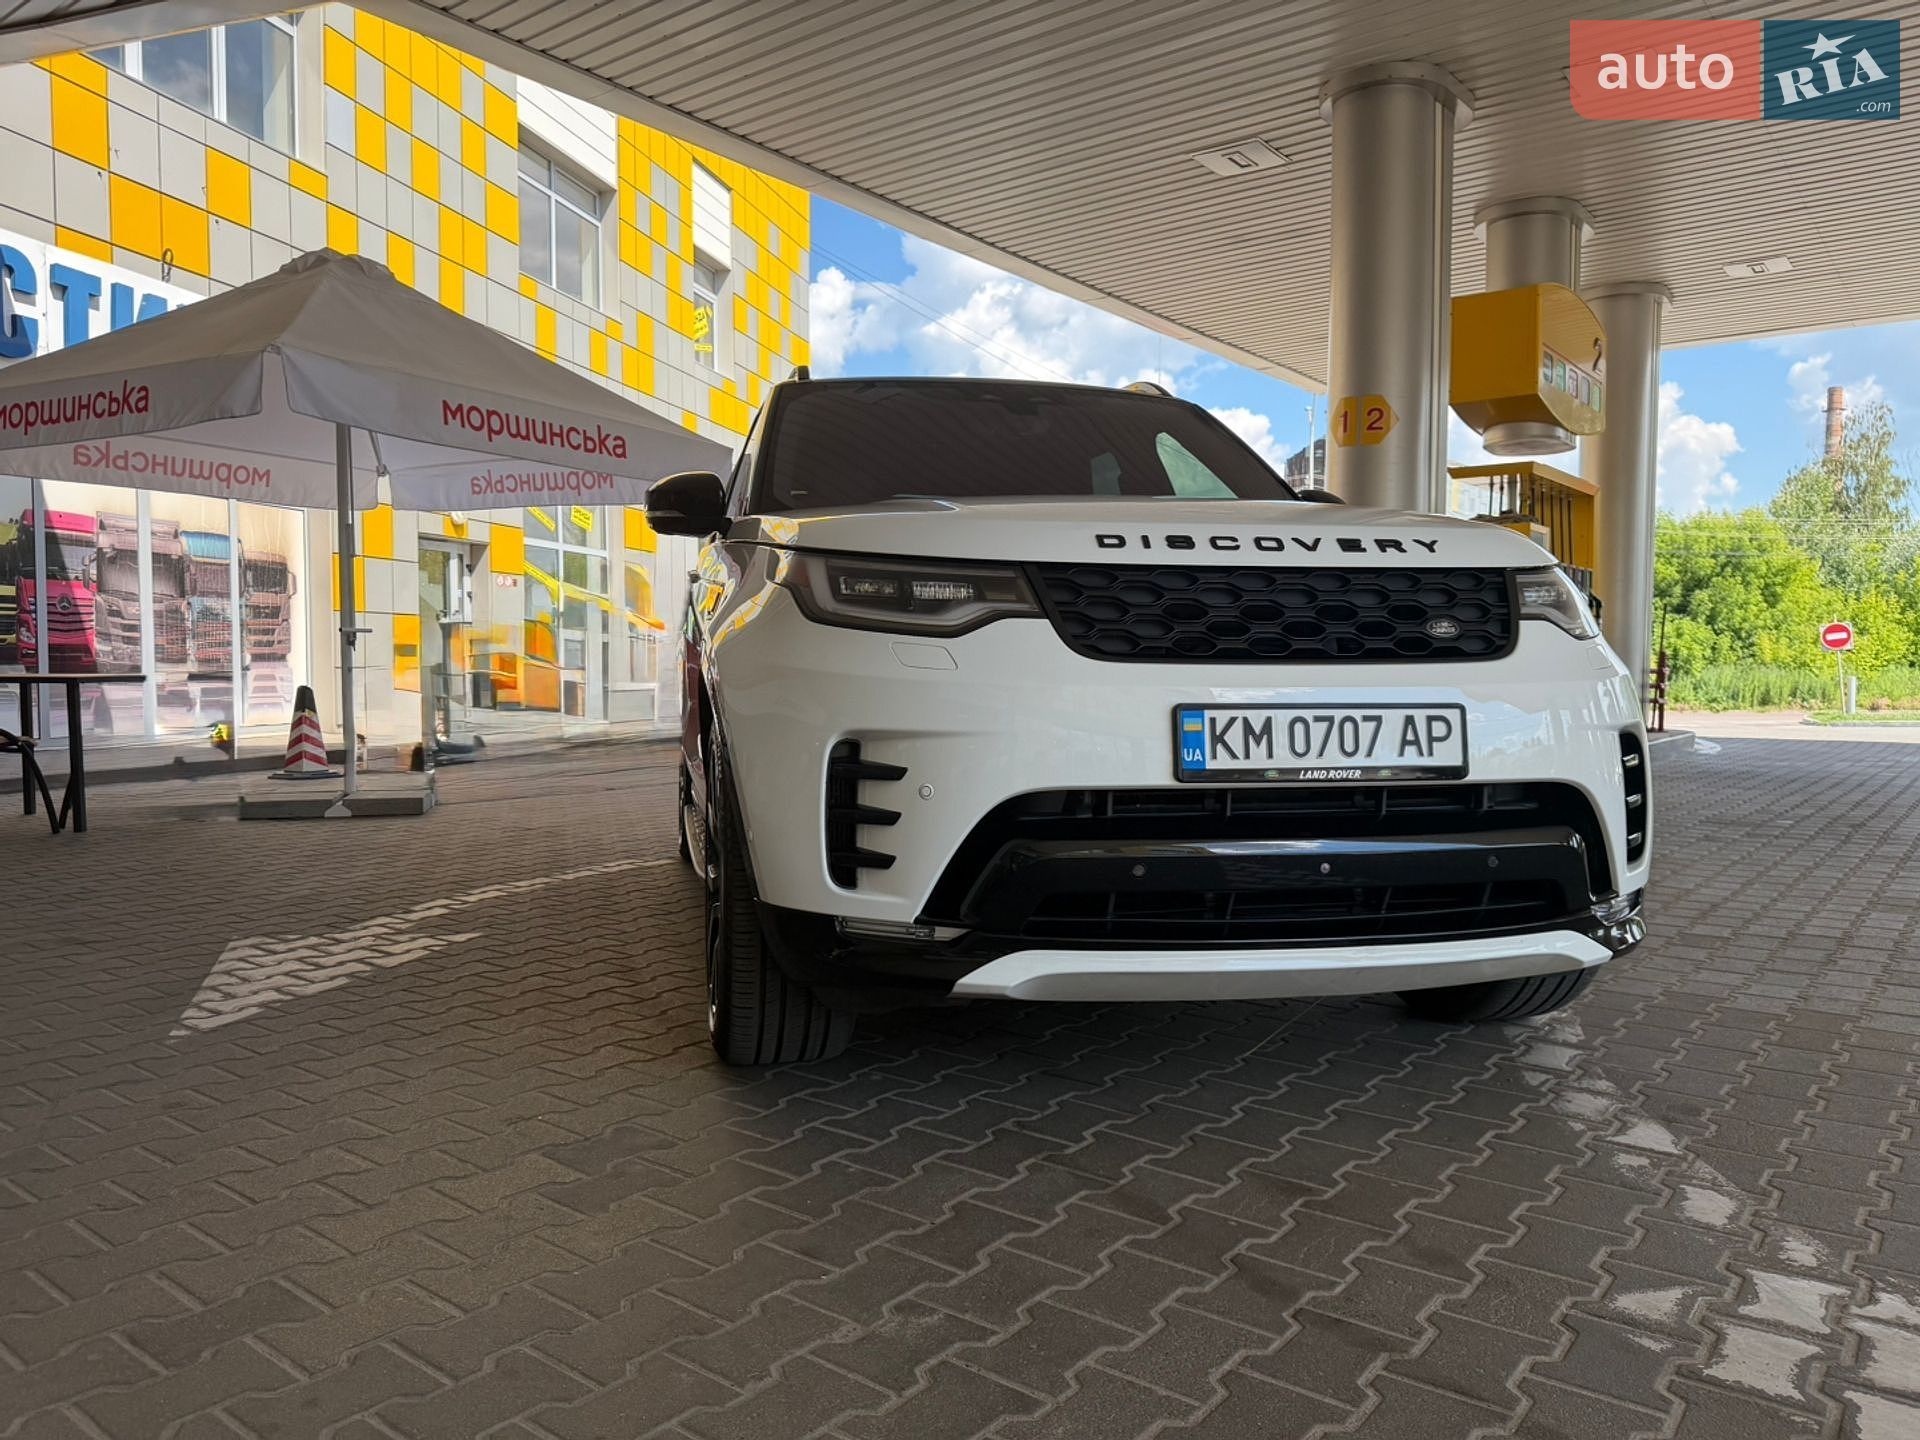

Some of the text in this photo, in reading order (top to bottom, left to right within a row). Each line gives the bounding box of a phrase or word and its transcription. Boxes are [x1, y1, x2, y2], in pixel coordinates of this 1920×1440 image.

[442, 400, 628, 460] моршинська
[1337, 407, 1384, 433] 1 2
[1095, 533, 1440, 554] DISCOVERY
[1208, 714, 1453, 760] KM 0707 AP
[1183, 748, 1204, 762] UA
[1299, 769, 1362, 779] LAND ROVER
